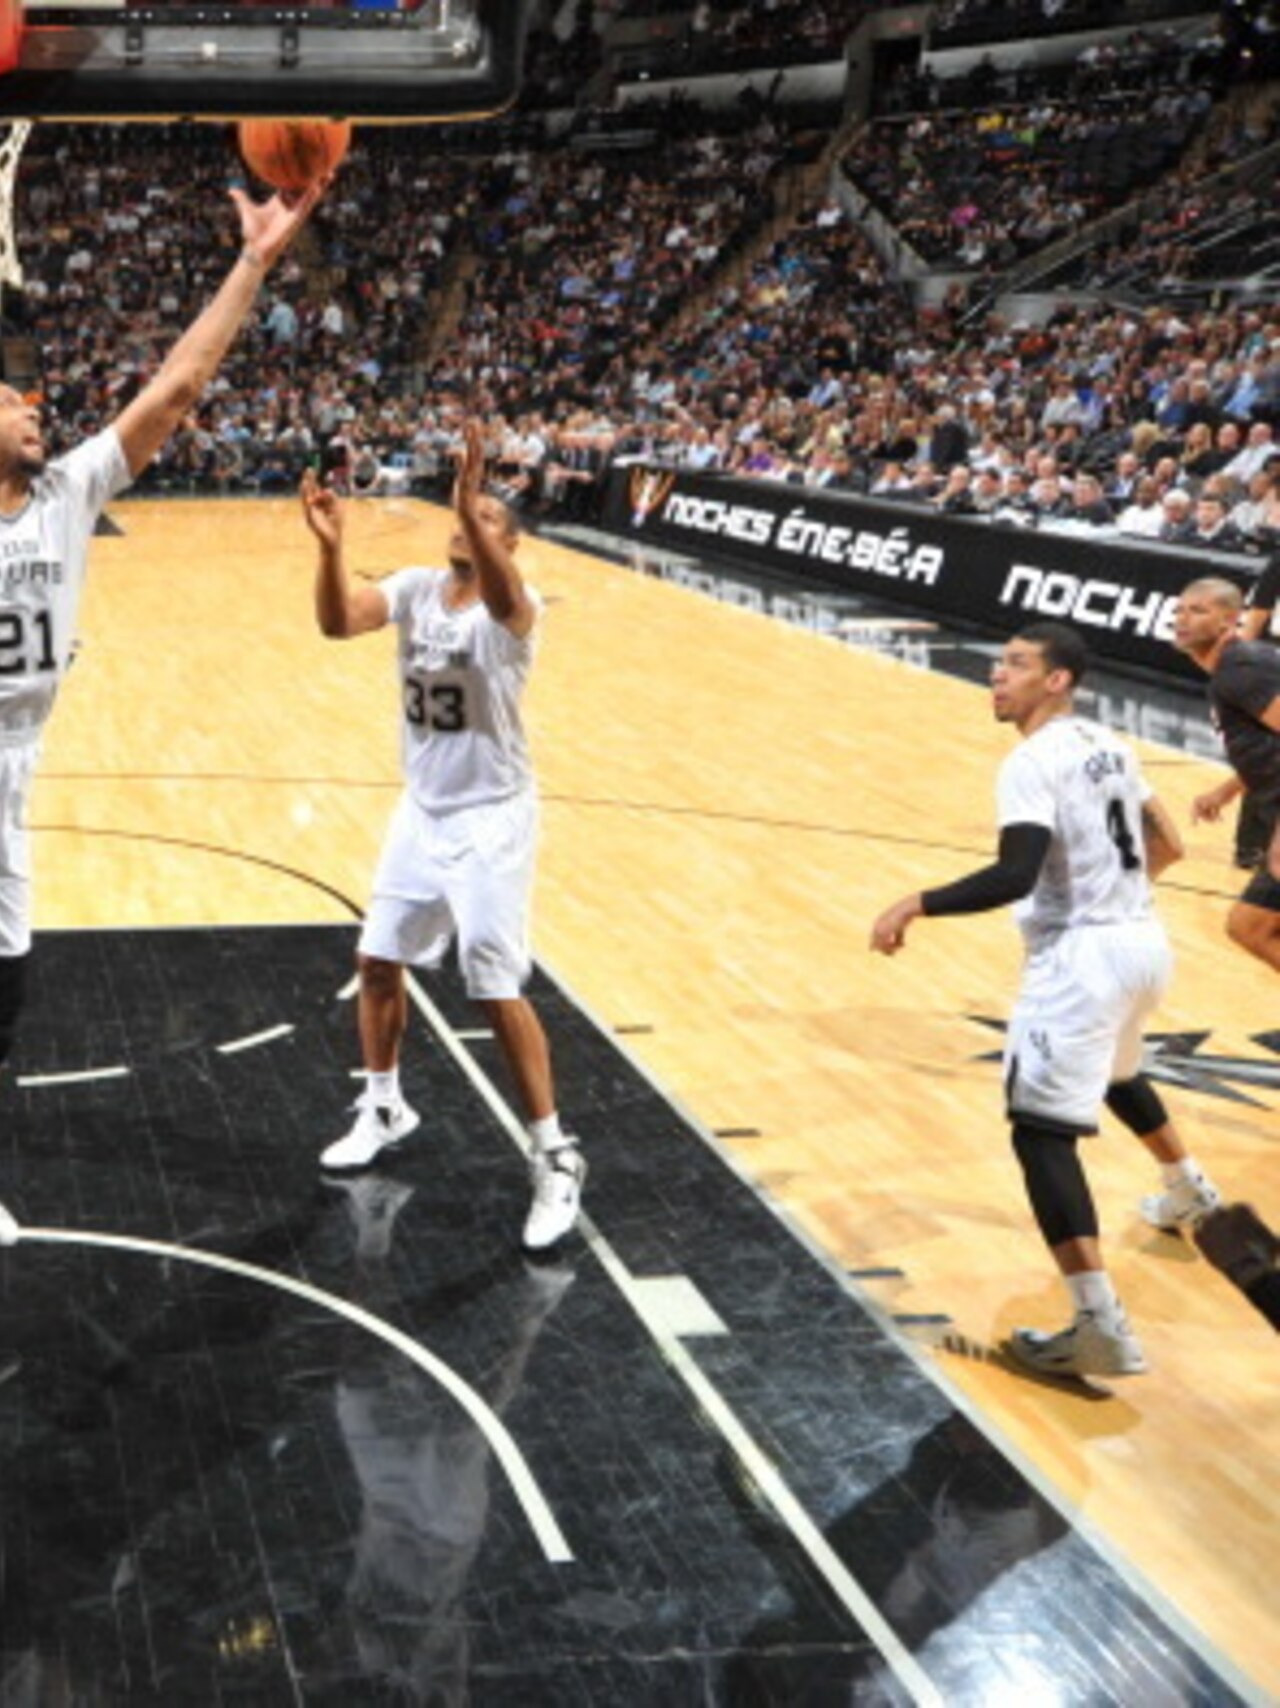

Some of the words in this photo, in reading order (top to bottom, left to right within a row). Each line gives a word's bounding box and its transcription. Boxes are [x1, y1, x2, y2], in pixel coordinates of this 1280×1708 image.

[663, 494, 775, 546] NOCHES
[998, 564, 1178, 642] NOCHE
[406, 677, 465, 733] 33
